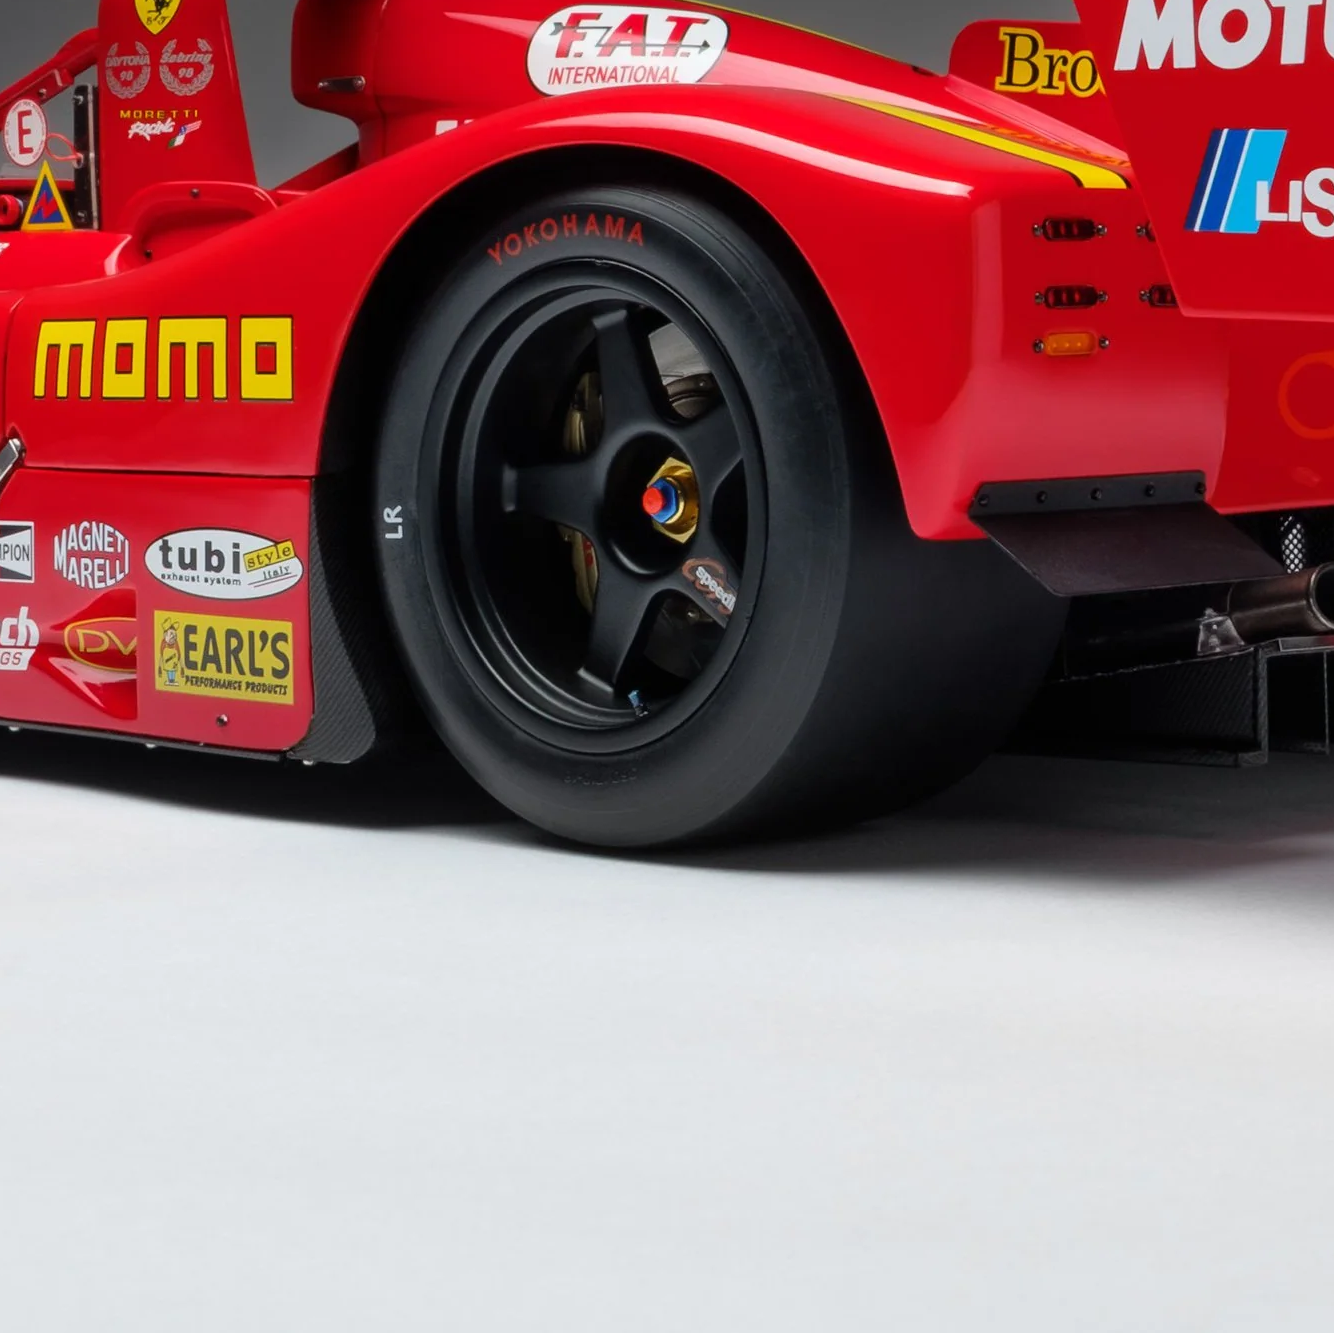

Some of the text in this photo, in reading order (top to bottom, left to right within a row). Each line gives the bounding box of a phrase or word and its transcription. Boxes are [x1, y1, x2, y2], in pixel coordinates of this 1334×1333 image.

[555, 13, 710, 58] F.A.T.
[548, 66, 680, 85] INTERNATIONAL
[997, 30, 1098, 93] Bro
[18, 110, 34, 154] E
[120, 110, 198, 118] MORETTI
[487, 214, 645, 265] YOKOHAMA
[383, 505, 403, 540] LR
[54, 521, 129, 569] MAGNETI
[159, 539, 241, 575] tubi
[247, 545, 292, 568] style
[54, 543, 129, 589] MARELLI
[161, 573, 242, 586] exhaust system
[183, 624, 290, 679] EARL'S
[184, 675, 288, 696] PERFORMANCE PRODUCTS
